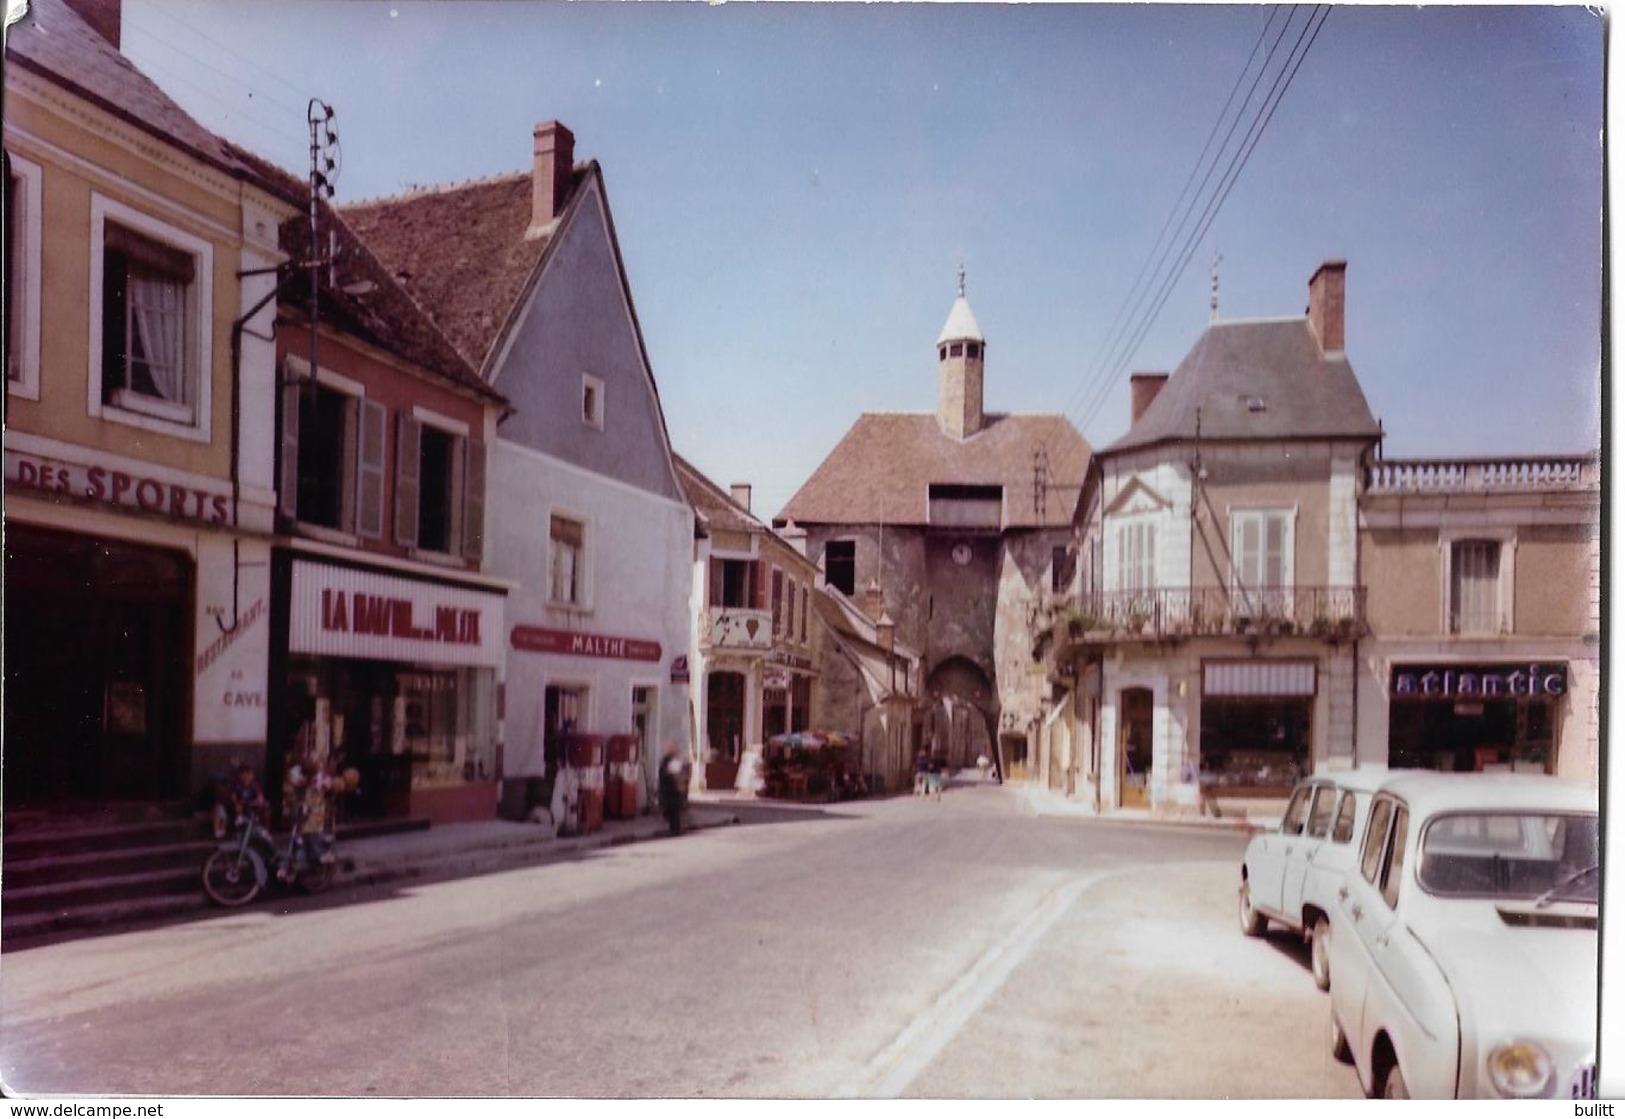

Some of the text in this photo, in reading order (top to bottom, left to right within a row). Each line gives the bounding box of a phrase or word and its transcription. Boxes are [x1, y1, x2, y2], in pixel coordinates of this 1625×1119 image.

[18, 461, 228, 525] DES SPORTS
[322, 588, 347, 632] LA
[1397, 664, 1563, 695] atlantic
